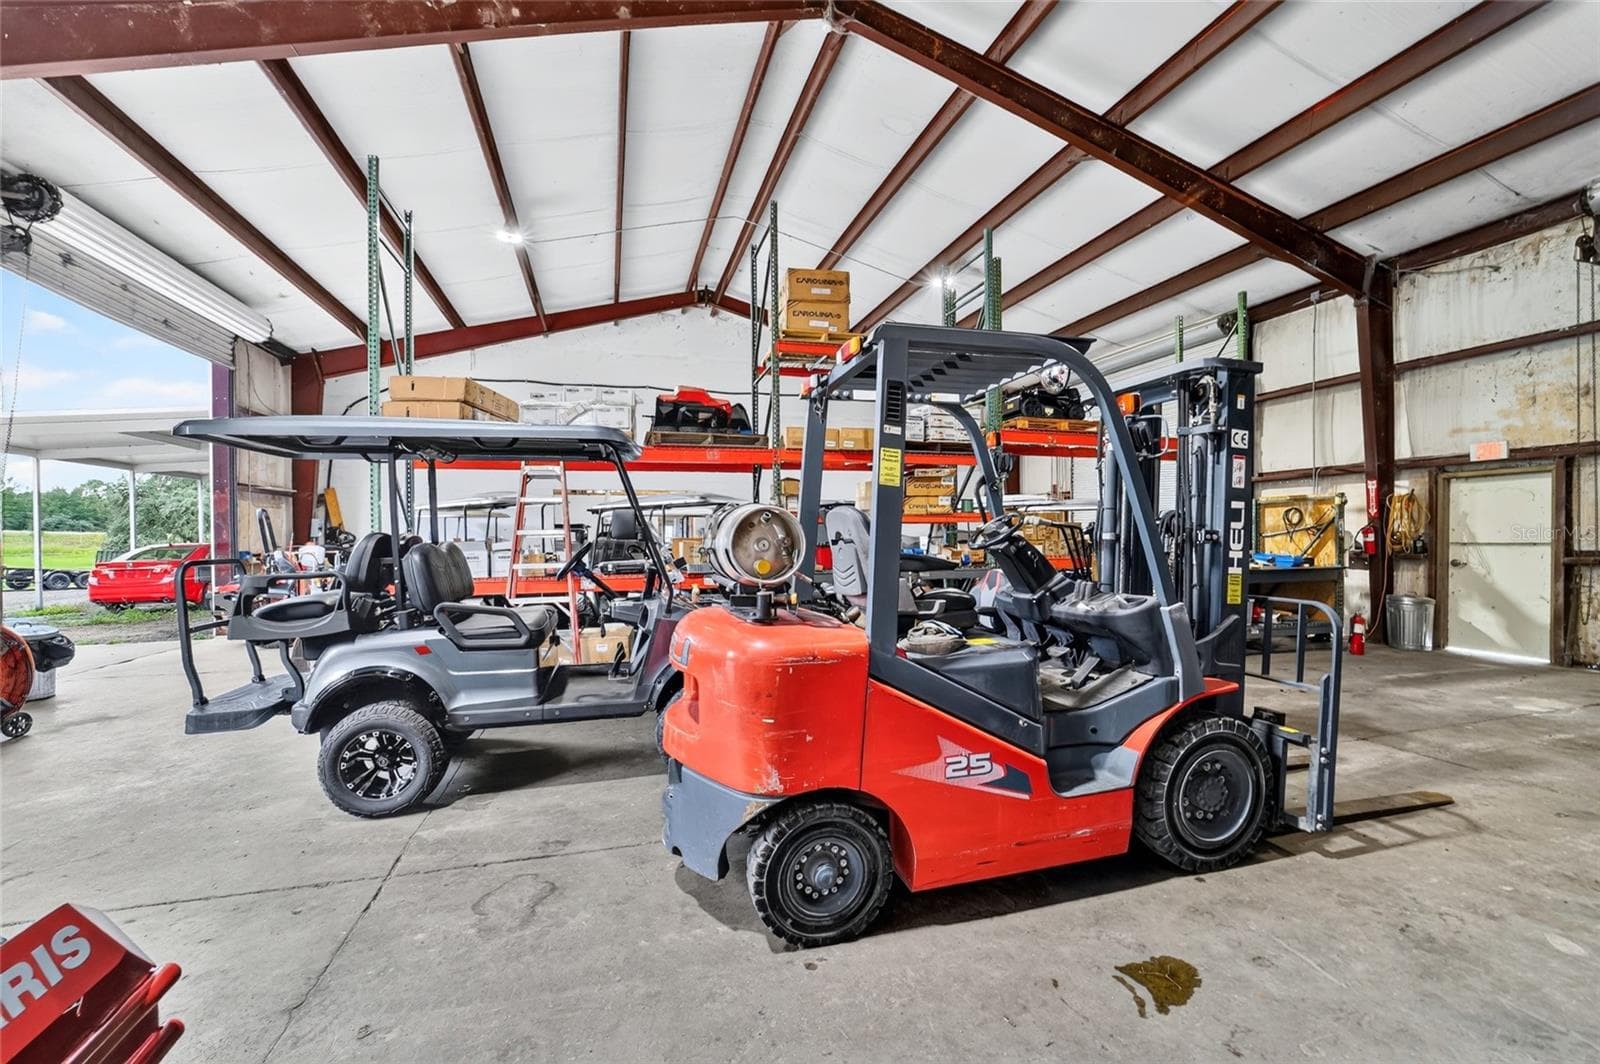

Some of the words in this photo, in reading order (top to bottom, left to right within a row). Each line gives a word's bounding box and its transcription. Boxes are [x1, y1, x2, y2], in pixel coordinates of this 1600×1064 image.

[792, 310, 834, 319] CAROLINA
[1233, 432, 1247, 446] CE
[1228, 501, 1245, 574] HELI
[945, 752, 993, 779] 25
[0, 924, 92, 1029] RIS
